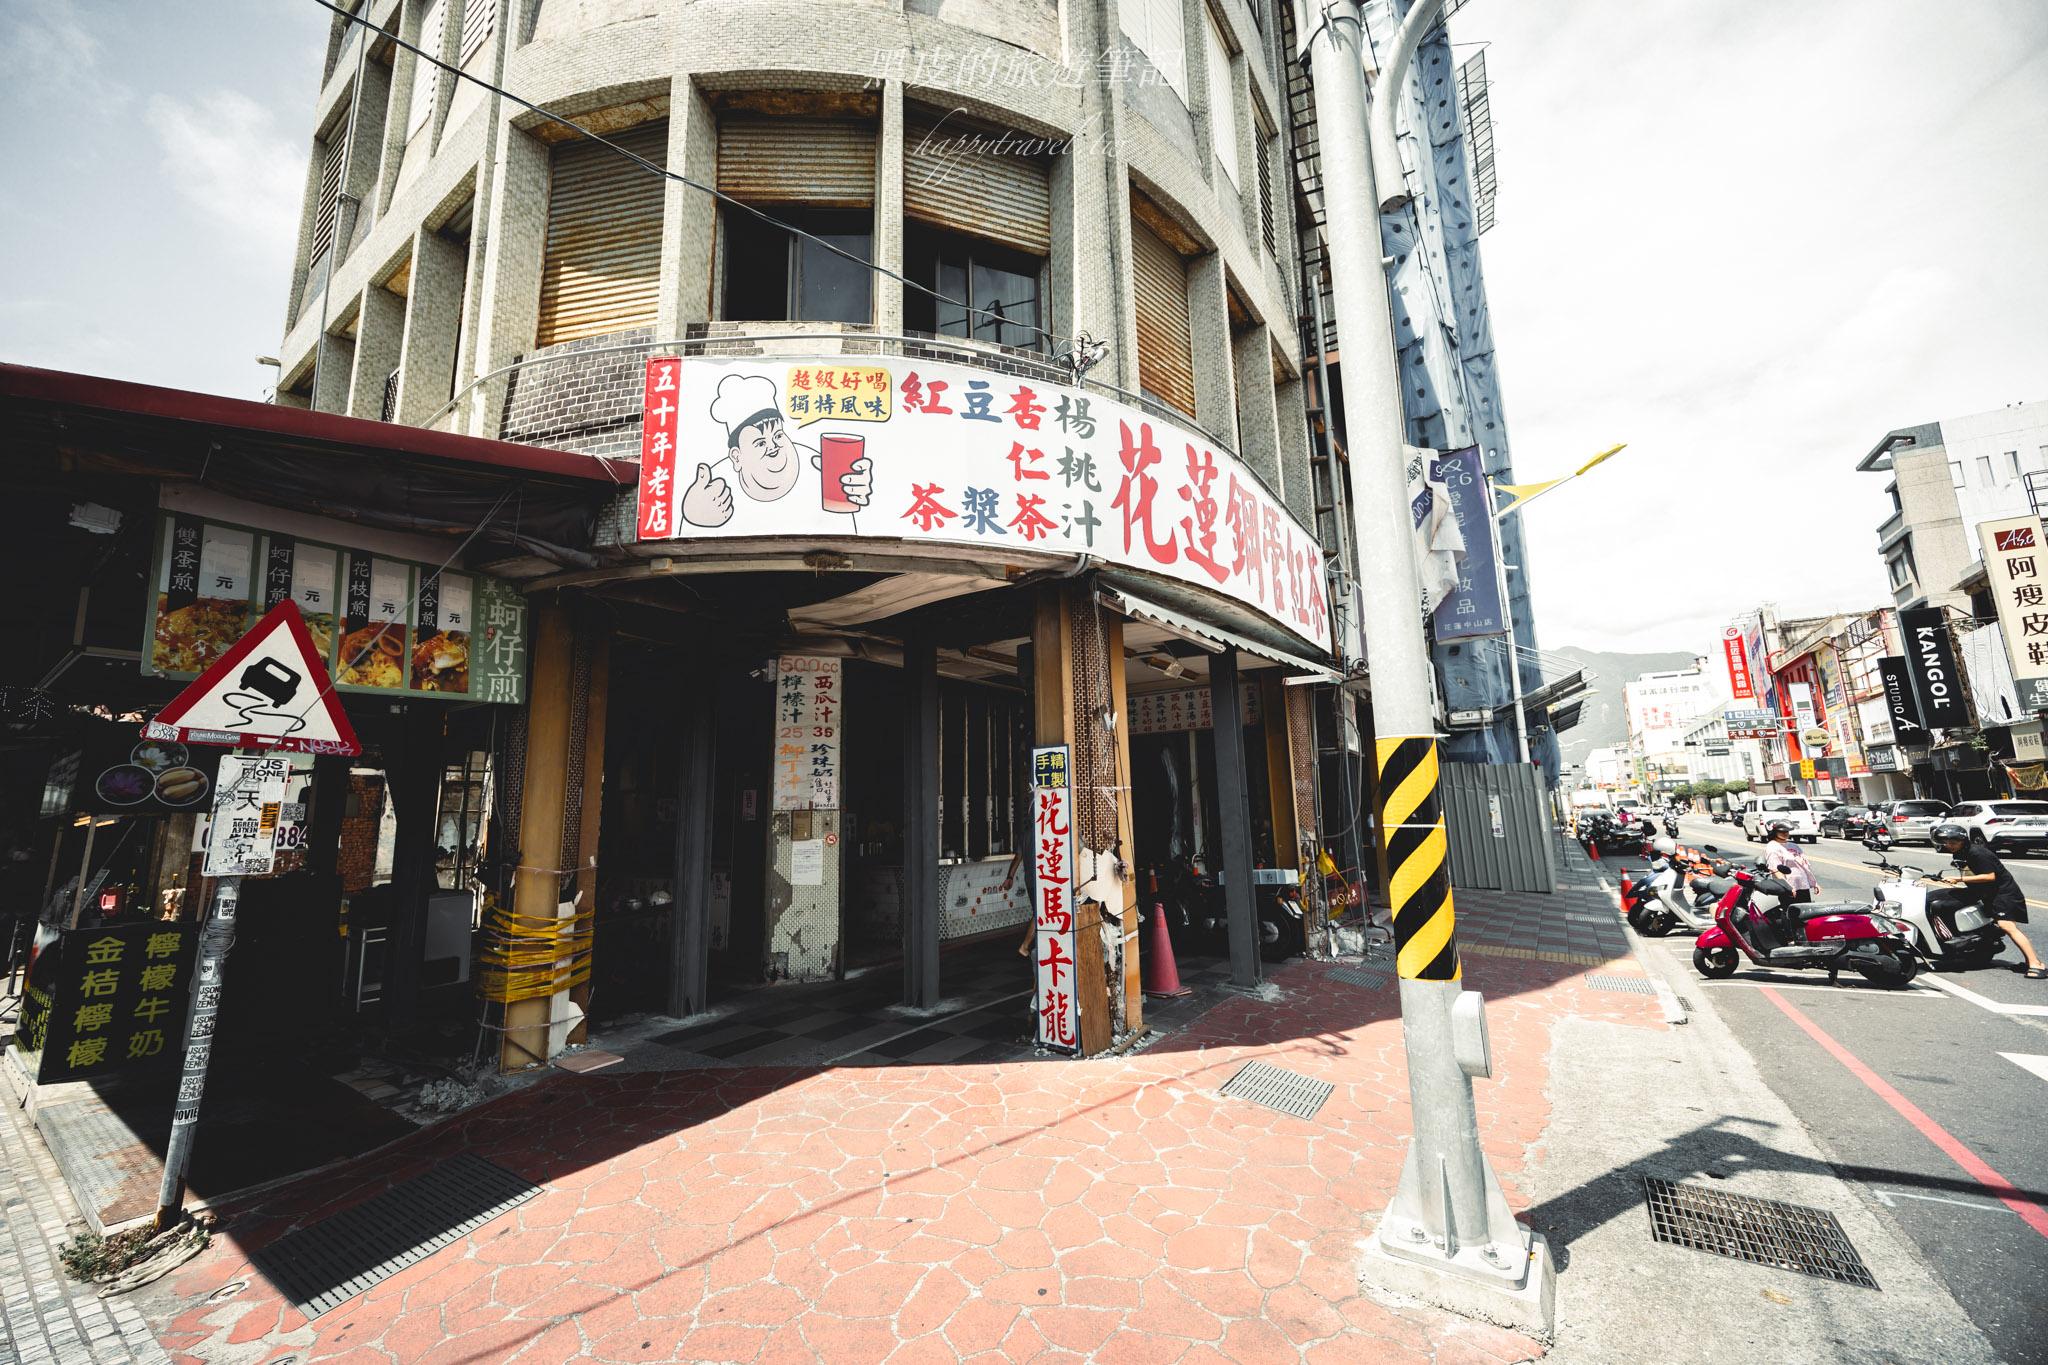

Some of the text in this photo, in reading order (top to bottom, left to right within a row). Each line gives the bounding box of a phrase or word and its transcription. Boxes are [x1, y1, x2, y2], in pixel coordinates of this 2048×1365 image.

[790, 396, 887, 417] 獨特風味
[791, 370, 887, 392] 超級好喝
[644, 366, 676, 532] 五十年老店
[900, 371, 958, 532] 紅茶
[960, 381, 1007, 536] 豆漿
[1002, 385, 1059, 541] 杏仁茶
[1054, 394, 1102, 548] 楊桃汁
[1110, 418, 1325, 641] 花蓮鋼管紅茶
[172, 527, 199, 592] 雙蛋煎
[216, 576, 233, 590] 元
[268, 544, 293, 604] 蚵仔煎
[349, 560, 370, 617] 花枝煎
[305, 590, 320, 603] 元
[382, 602, 395, 614] 元
[419, 576, 438, 627] 綜合煎
[449, 613, 461, 624] 元
[486, 599, 526, 704] 蚵仔煎
[1916, 626, 1950, 709] KANGOL
[781, 675, 806, 723] 檸檬汁
[814, 675, 837, 723] 西瓜汁
[1886, 674, 1905, 714] STUDIO
[780, 727, 804, 739] 25
[260, 760, 283, 770] JS
[1036, 792, 1075, 1046] 花蓮馬卡龍
[66, 936, 126, 1069] 金桔檸檬
[126, 932, 182, 1059] 檸檬牛奶
